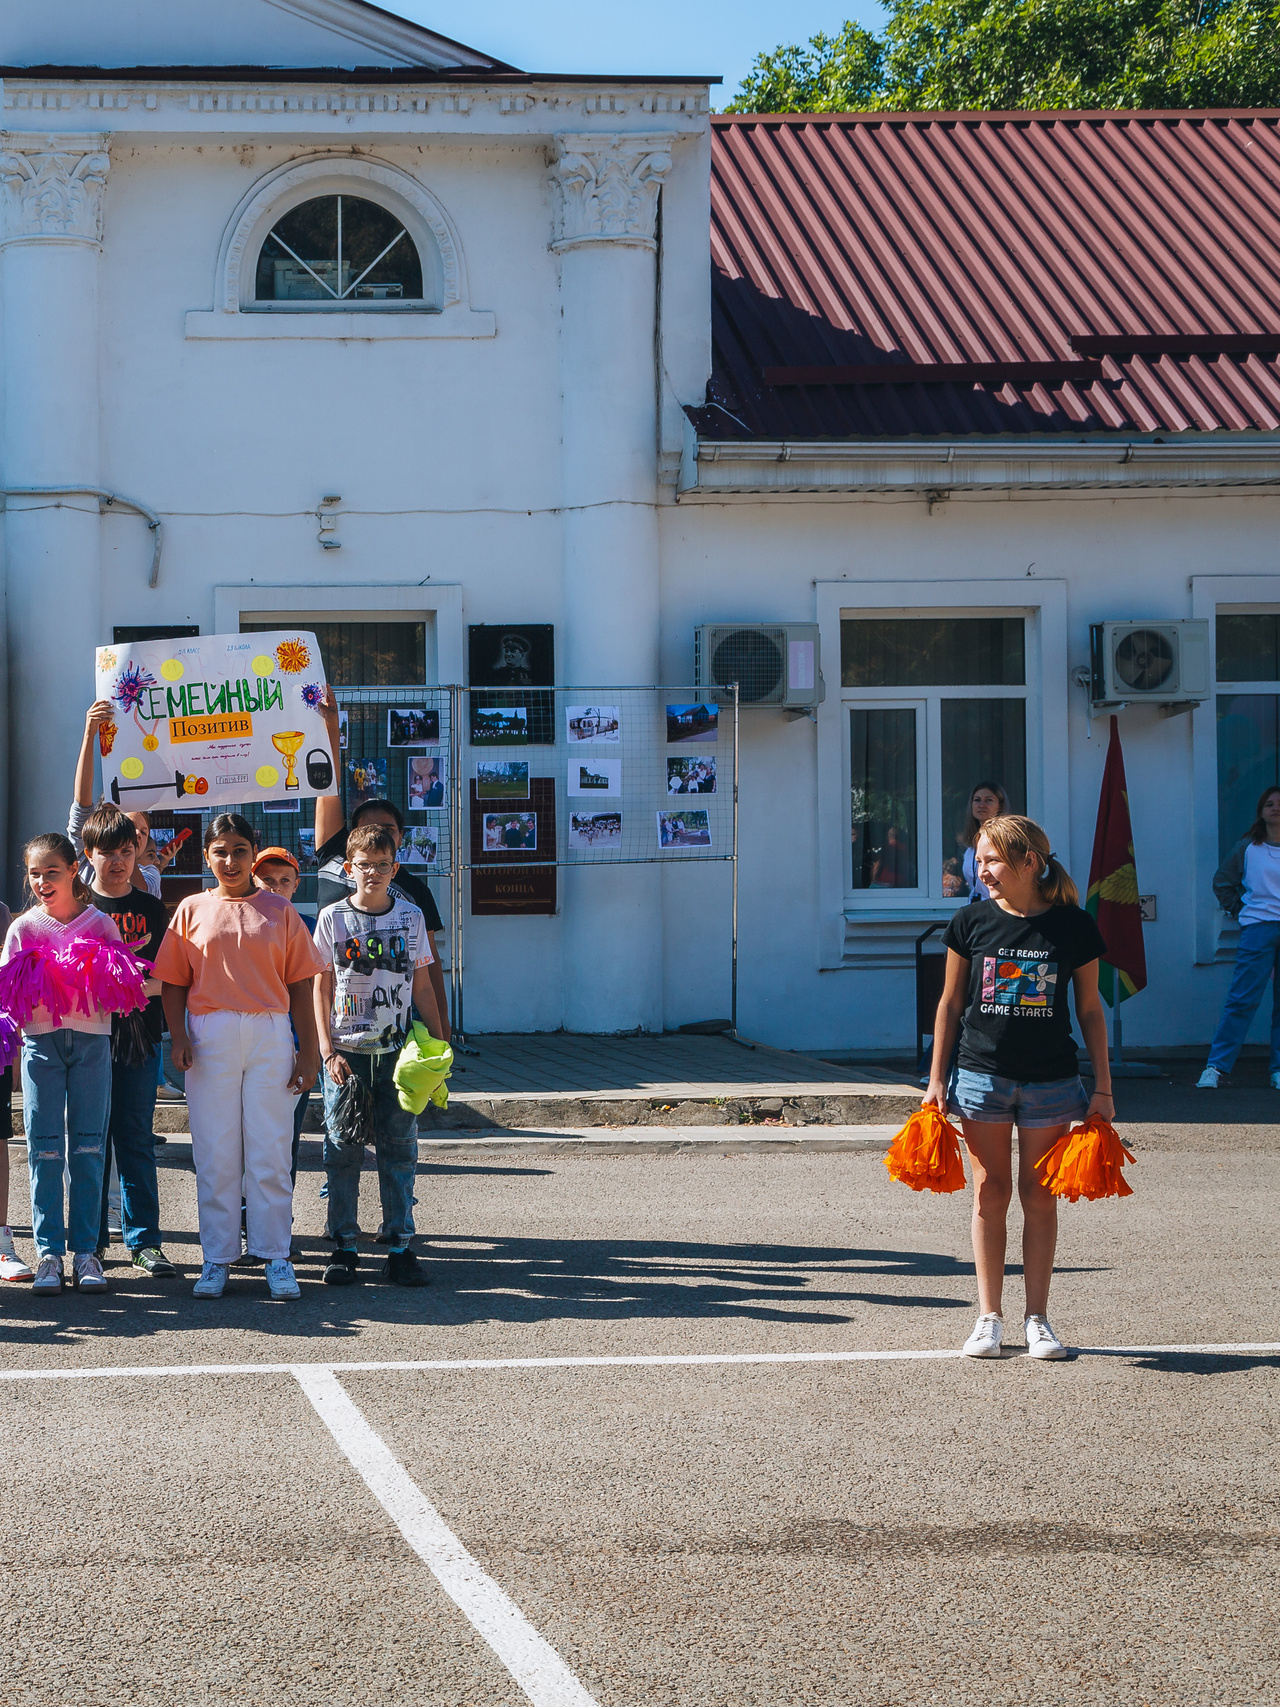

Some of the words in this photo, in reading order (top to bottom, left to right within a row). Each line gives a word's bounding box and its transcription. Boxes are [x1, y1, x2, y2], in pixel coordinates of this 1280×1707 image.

[136, 677, 284, 721] СЕМЕЙНЫЙ
[172, 717, 250, 738] Позитив
[495, 884, 535, 894] КОНЦА
[345, 935, 405, 960] 890
[998, 947, 1015, 957] GET
[1017, 949, 1049, 959] READY?
[980, 1003, 1010, 1016] GAME
[1013, 1006, 1053, 1017] STARTS
